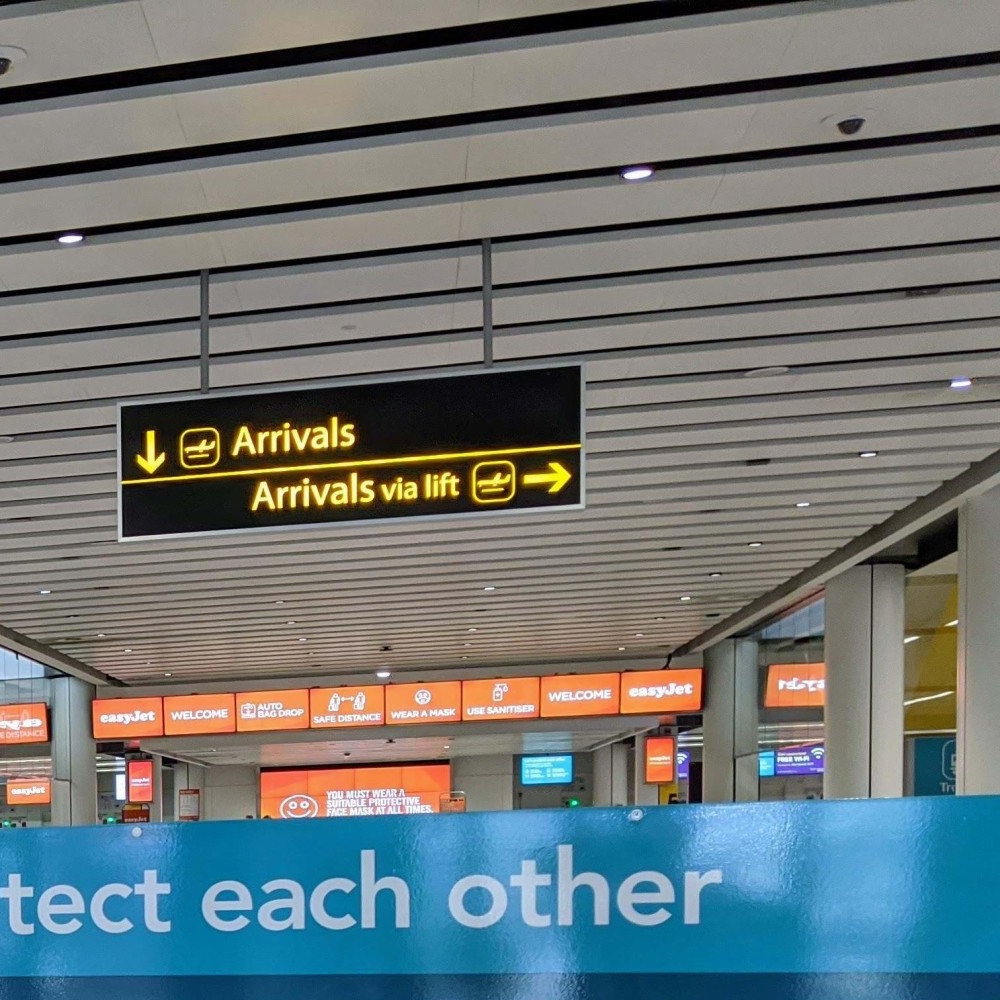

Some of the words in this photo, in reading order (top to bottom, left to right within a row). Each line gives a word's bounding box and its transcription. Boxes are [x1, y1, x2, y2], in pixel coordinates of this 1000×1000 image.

[232, 416, 356, 456] Arrivals
[251, 472, 375, 511] Arrivals
[380, 477, 418, 502] via
[424, 472, 460, 498] lift
[548, 689, 612, 702] WELCOME
[629, 682, 693, 698] easyJet
[257, 702, 283, 710] AUTO
[467, 706, 485, 716] USE
[486, 704, 535, 715] SANITISER
[100, 710, 155, 724] easyJet
[170, 709, 229, 721] WELCOME
[257, 710, 278, 718] BAG
[278, 708, 304, 717] DROP
[313, 714, 337, 724] SAFE
[338, 712, 382, 723] DISTANCE
[391, 710, 419, 719] WEAR
[420, 709, 428, 718] A
[429, 708, 456, 717] MASK
[11, 786, 45, 796] easyJet
[326, 790, 344, 800] YOU
[346, 789, 370, 799] MUST
[372, 788, 398, 798] WEAR
[399, 788, 405, 797] A
[326, 798, 367, 808] SUITABLE
[368, 796, 420, 807] PROTECTIVE
[327, 807, 348, 817] FACE
[349, 806, 374, 816] MASK
[375, 805, 386, 815] AT
[386, 805, 404, 815] ALL
[405, 804, 434, 814] TIMES.
[200, 849, 411, 932] each
[447, 843, 723, 928] other
